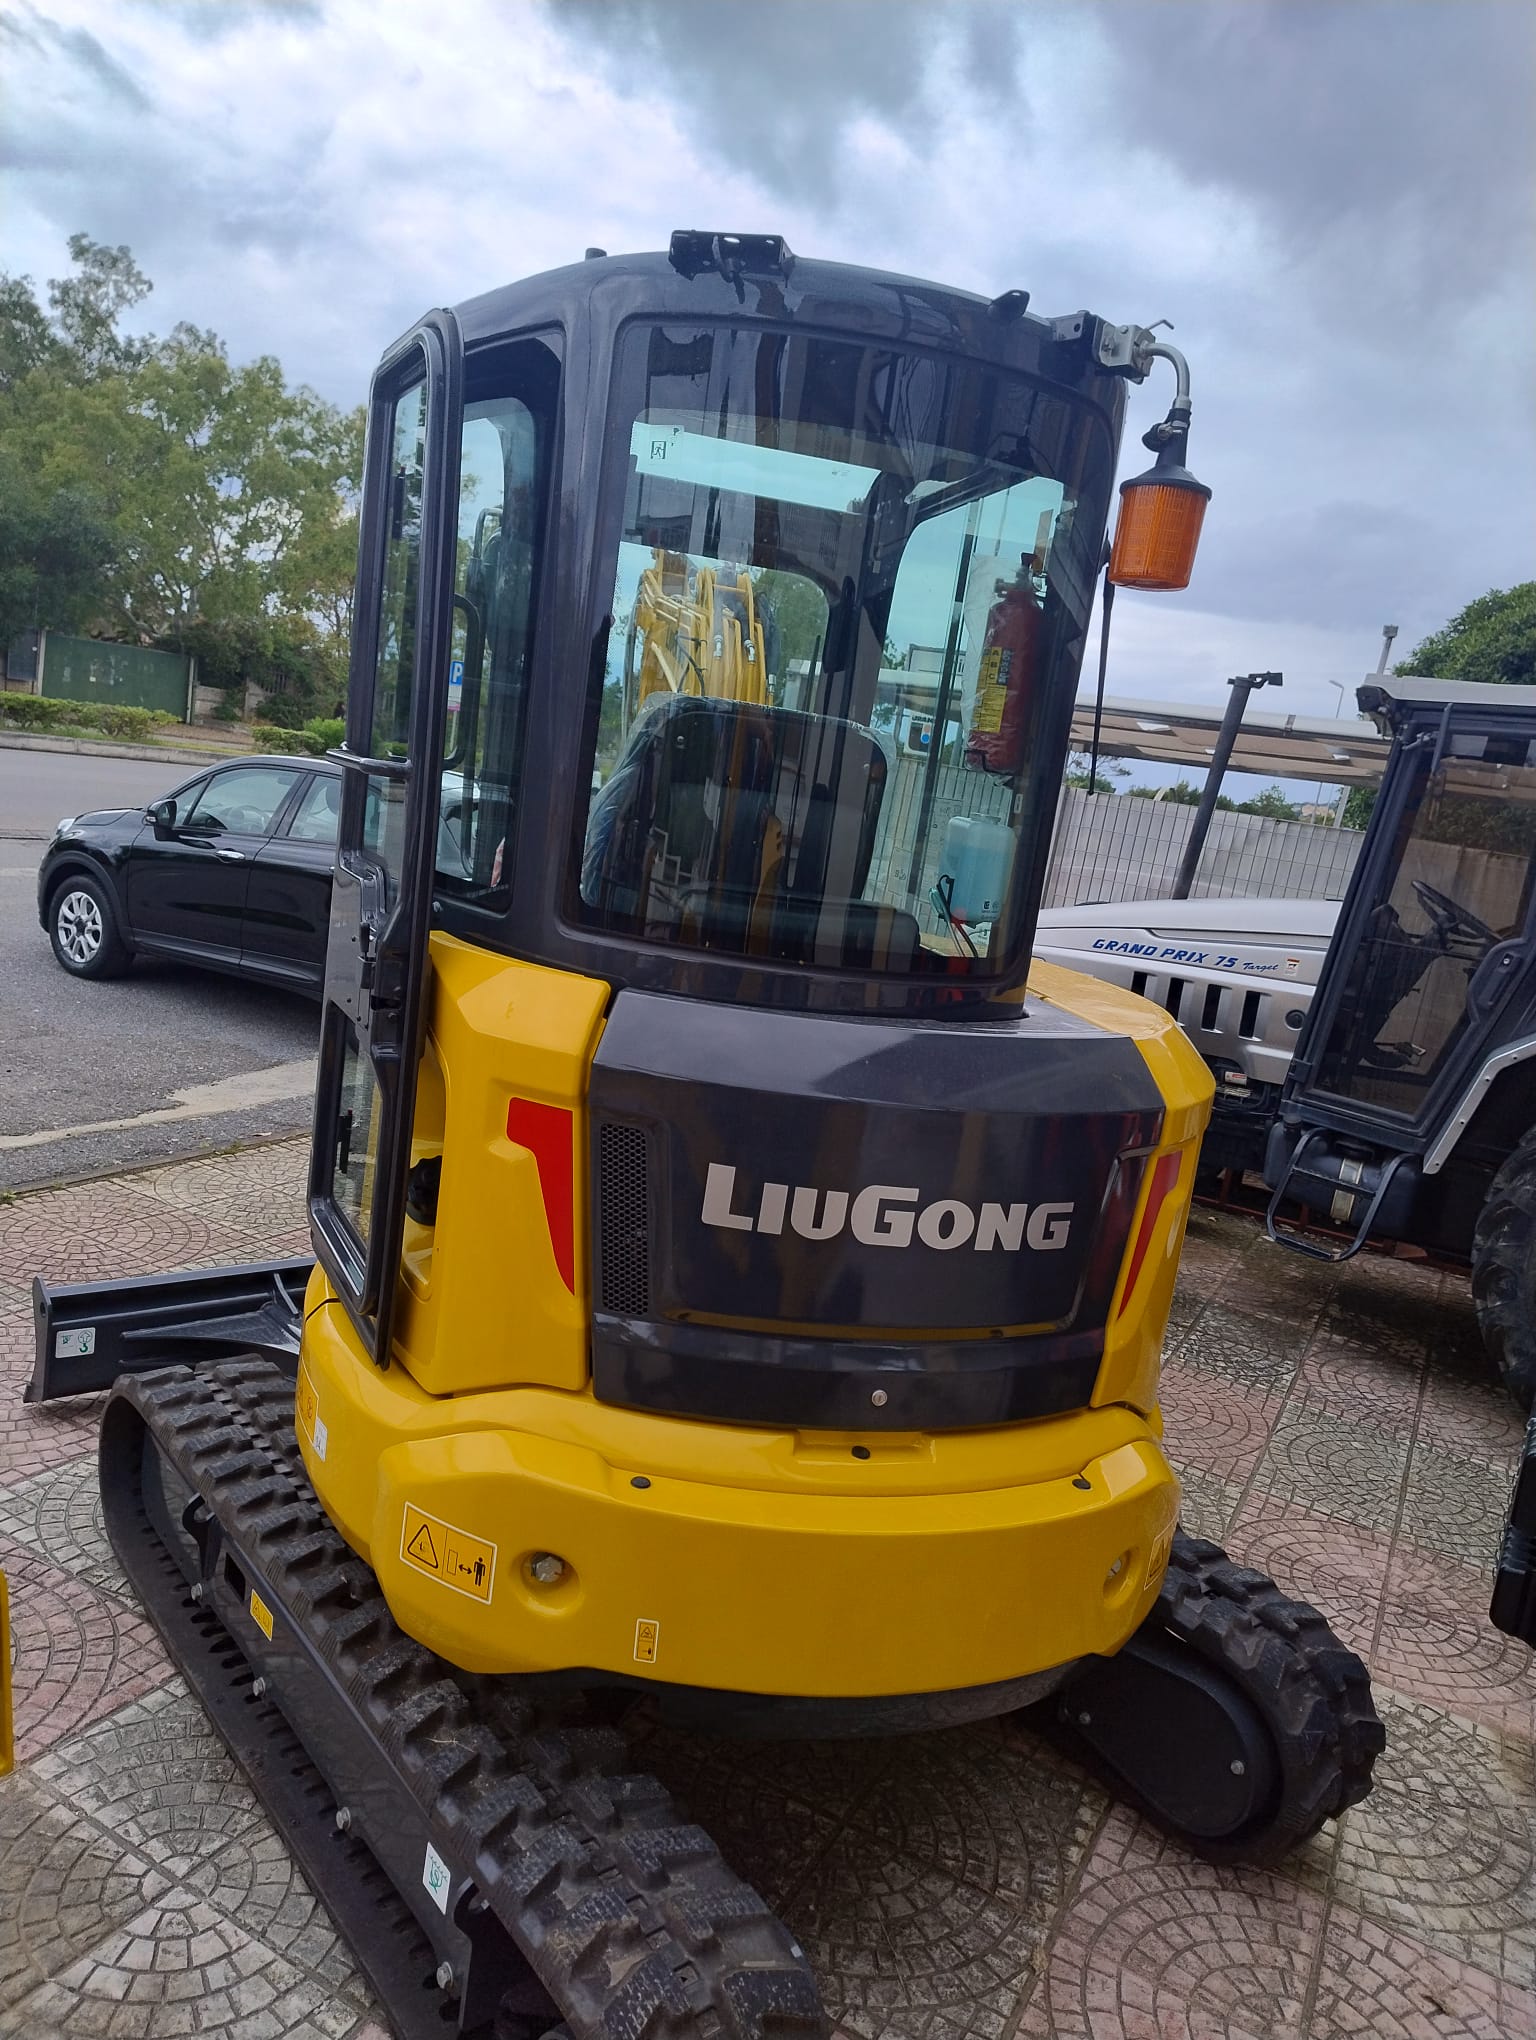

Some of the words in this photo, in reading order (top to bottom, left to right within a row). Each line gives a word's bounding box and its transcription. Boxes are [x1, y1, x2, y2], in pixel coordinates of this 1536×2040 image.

[452, 662, 463, 683] P
[1092, 939, 1157, 956] GRAND
[1160, 948, 1210, 964] PRIX
[1214, 956, 1239, 968] 75
[1242, 962, 1279, 971] Target
